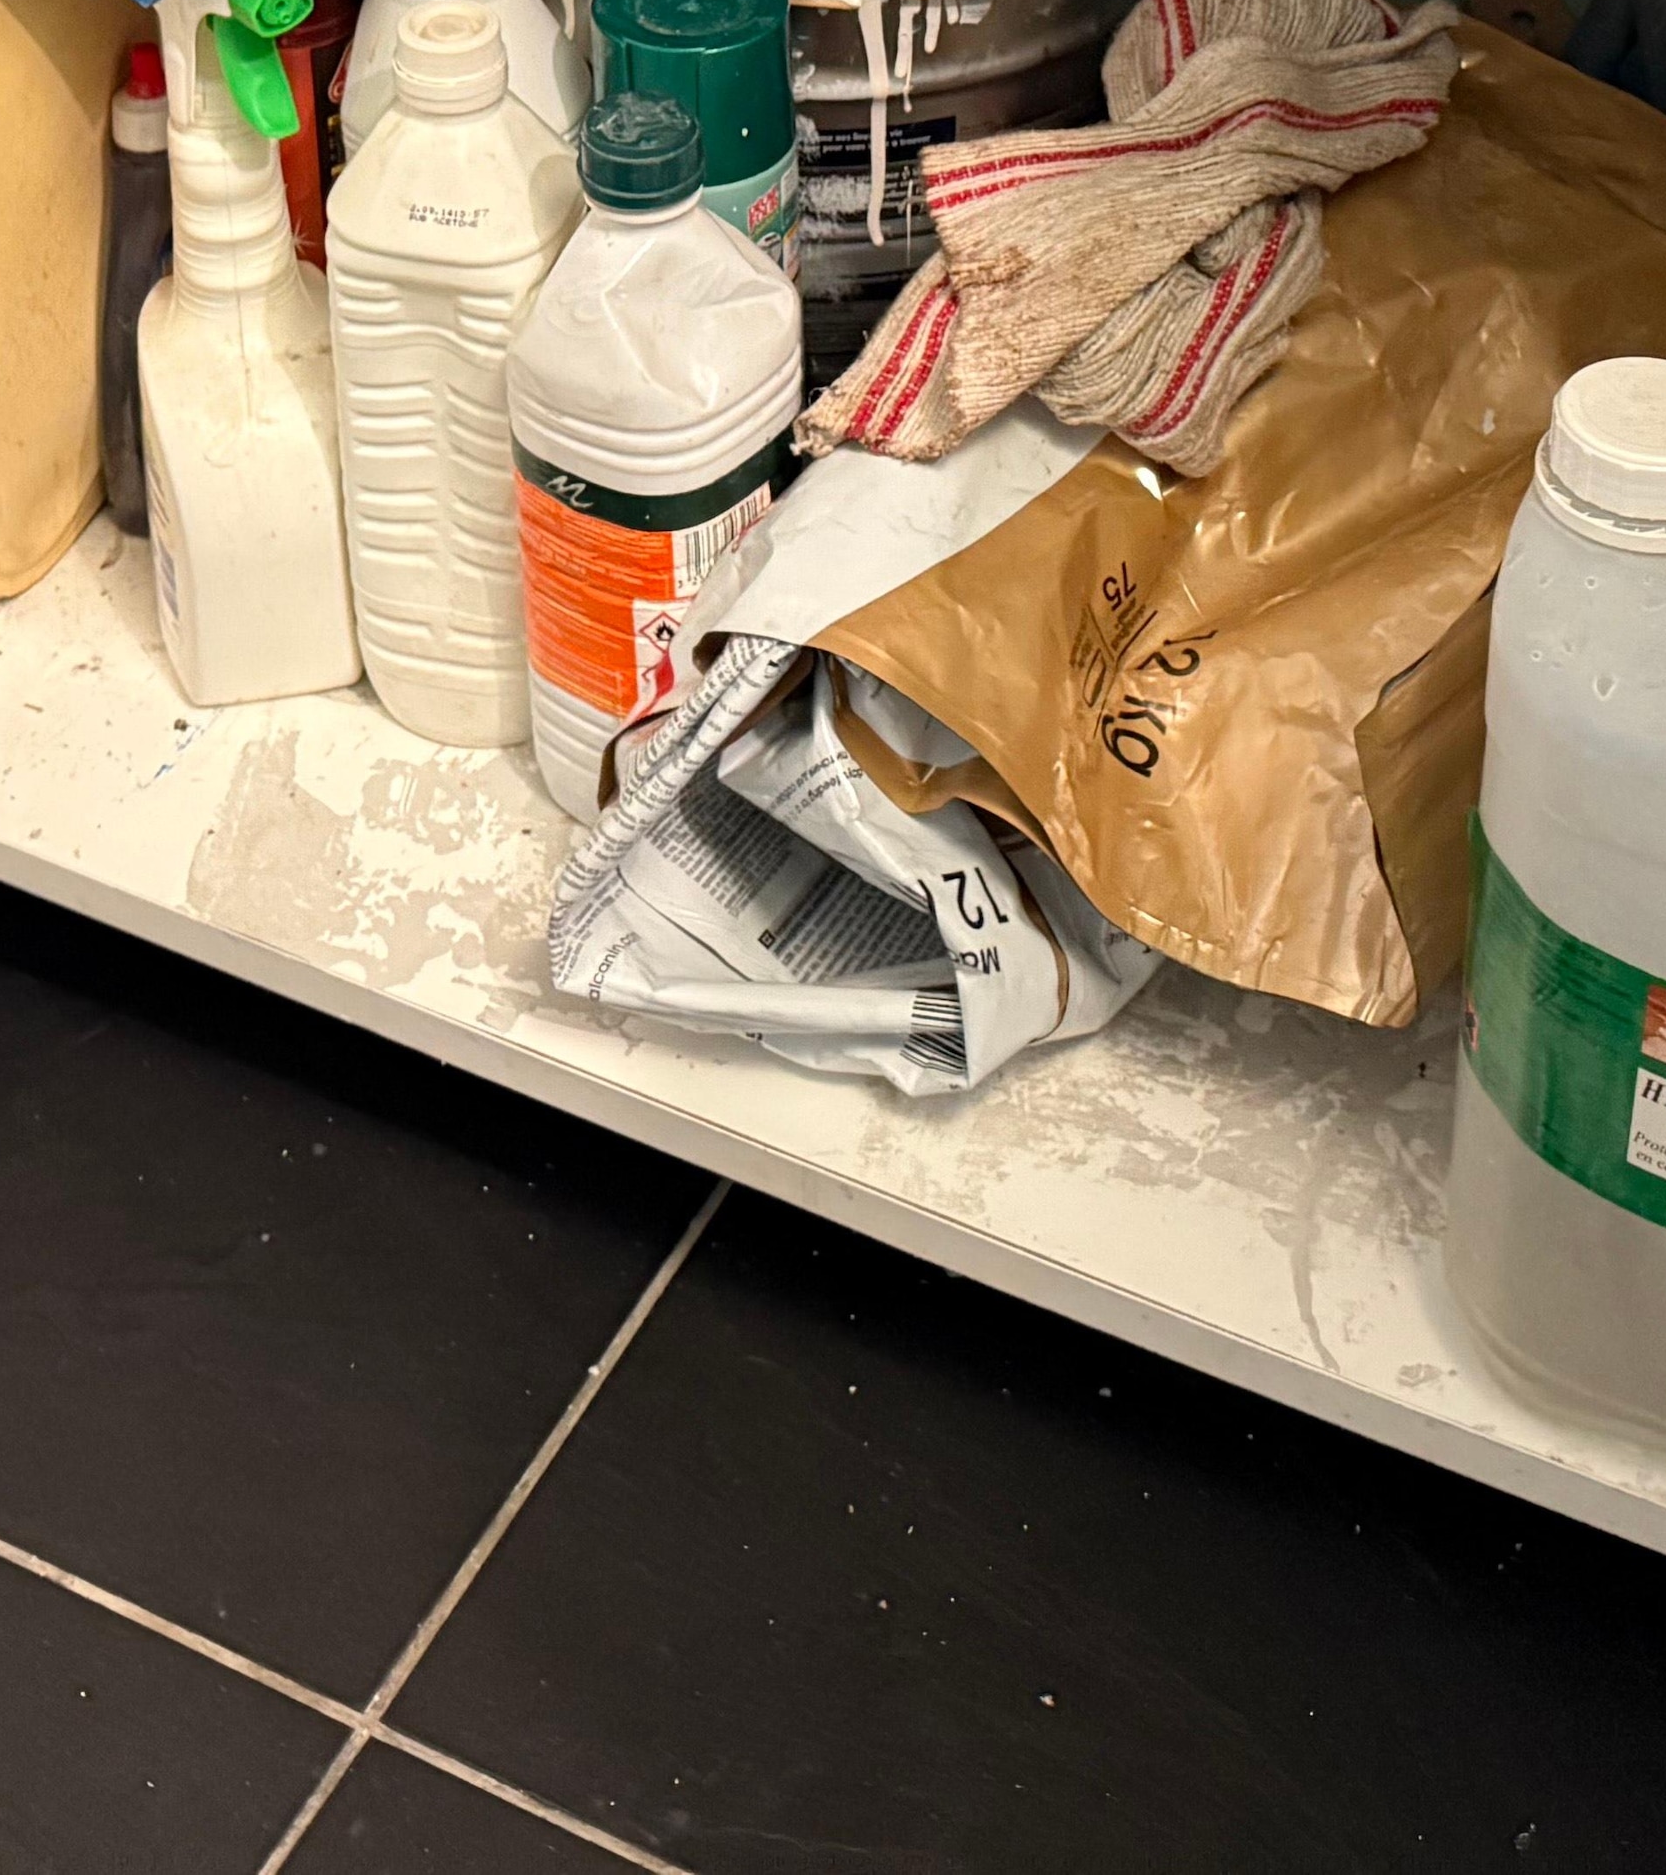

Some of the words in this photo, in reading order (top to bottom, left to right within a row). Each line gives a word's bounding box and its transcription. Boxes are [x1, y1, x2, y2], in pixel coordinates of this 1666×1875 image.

[1102, 560, 1137, 611] 75
[1136, 629, 1220, 677] 12
[941, 866, 1009, 929] 12
[950, 946, 1002, 975] Ma
[1635, 1151, 1654, 1166] en
